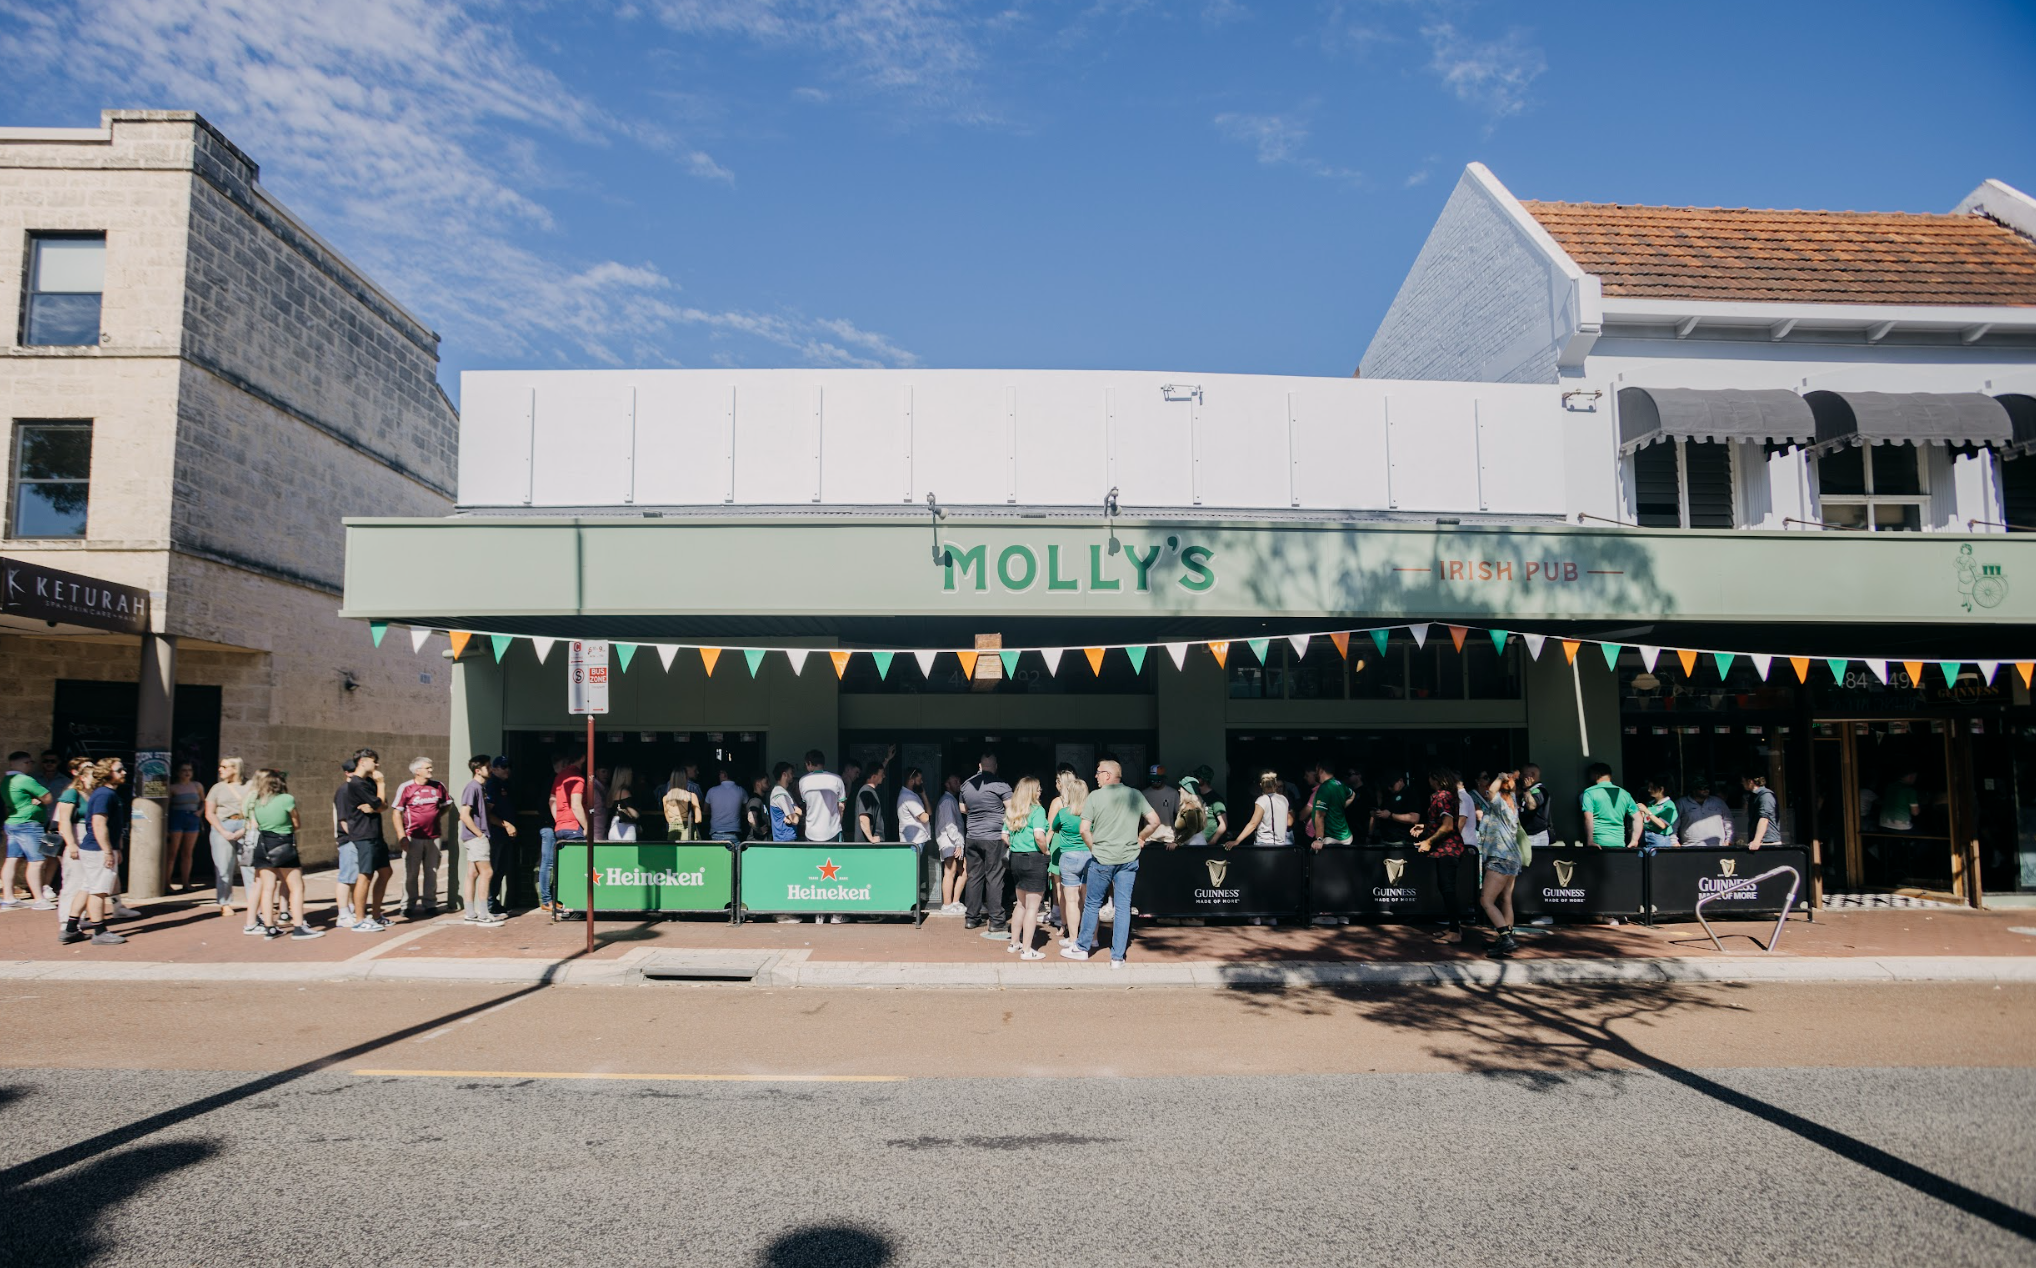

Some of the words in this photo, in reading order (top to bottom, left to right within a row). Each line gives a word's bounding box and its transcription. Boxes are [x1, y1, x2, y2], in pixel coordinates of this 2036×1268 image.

[942, 535, 1218, 594] MOLLY'S
[1439, 560, 1513, 582] IRISH
[1525, 561, 1579, 582] PUB
[36, 576, 145, 616] KETURAH
[589, 675, 607, 683] ZONE
[1937, 686, 1999, 699] GUINNESS
[606, 867, 705, 886] Heineken
[787, 884, 871, 900] Heineken
[1194, 888, 1240, 898] GUINNESS
[1372, 886, 1417, 897] GUINNESS
[1542, 887, 1586, 897] GUINNESS
[1734, 892, 1758, 900] MORE
